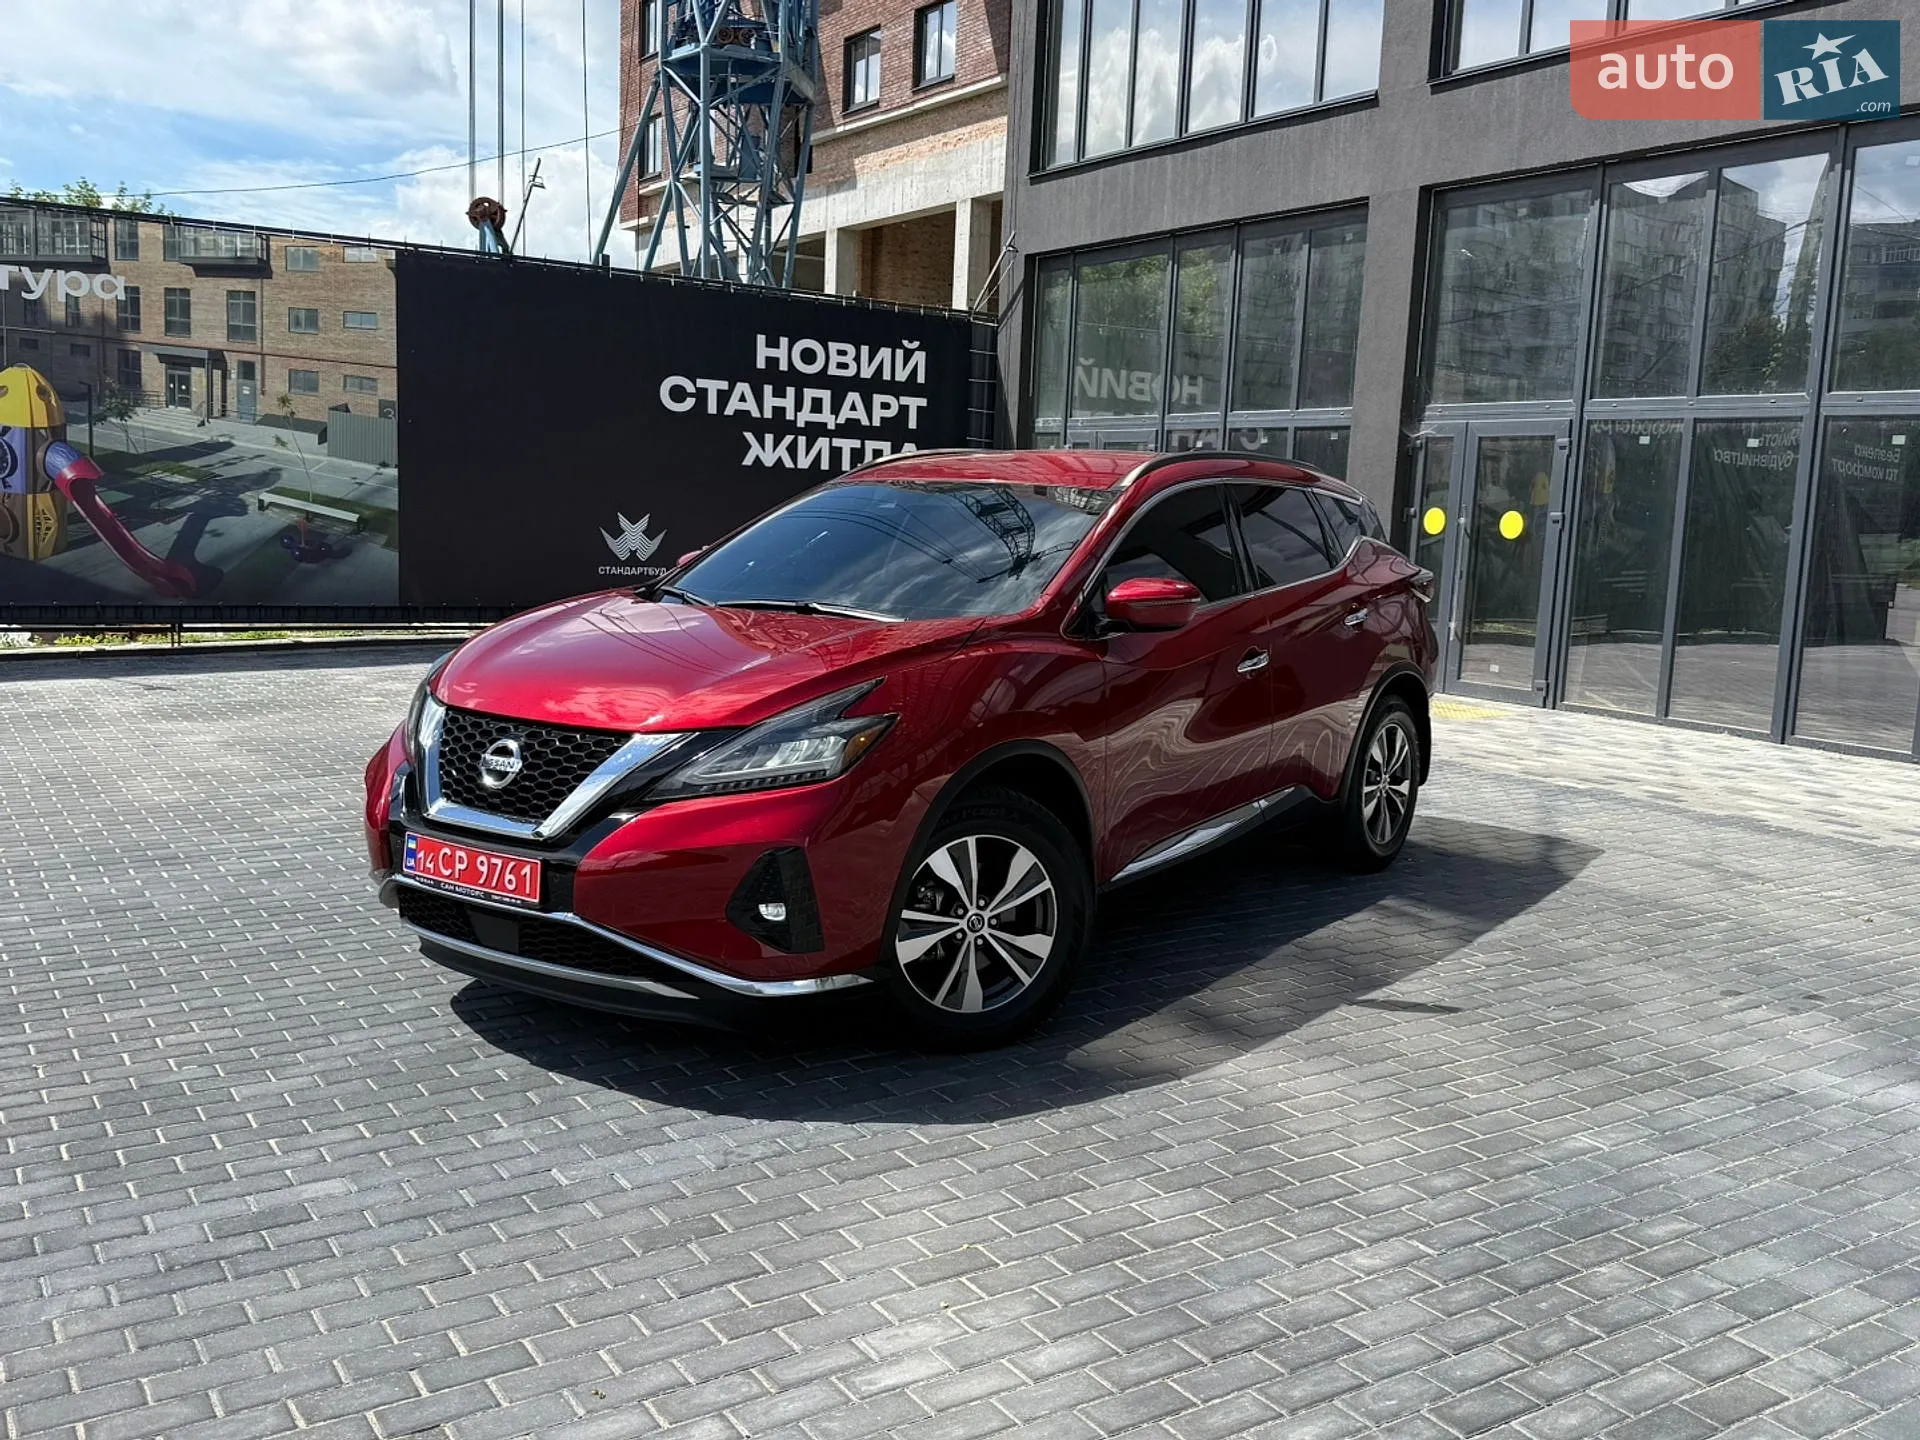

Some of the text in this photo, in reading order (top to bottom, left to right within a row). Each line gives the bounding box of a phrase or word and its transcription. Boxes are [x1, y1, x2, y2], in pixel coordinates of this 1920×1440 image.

[756, 334, 927, 384] НОВИЙ
[659, 375, 927, 430] СТАНДАРТ
[476, 856, 531, 894] 9761
